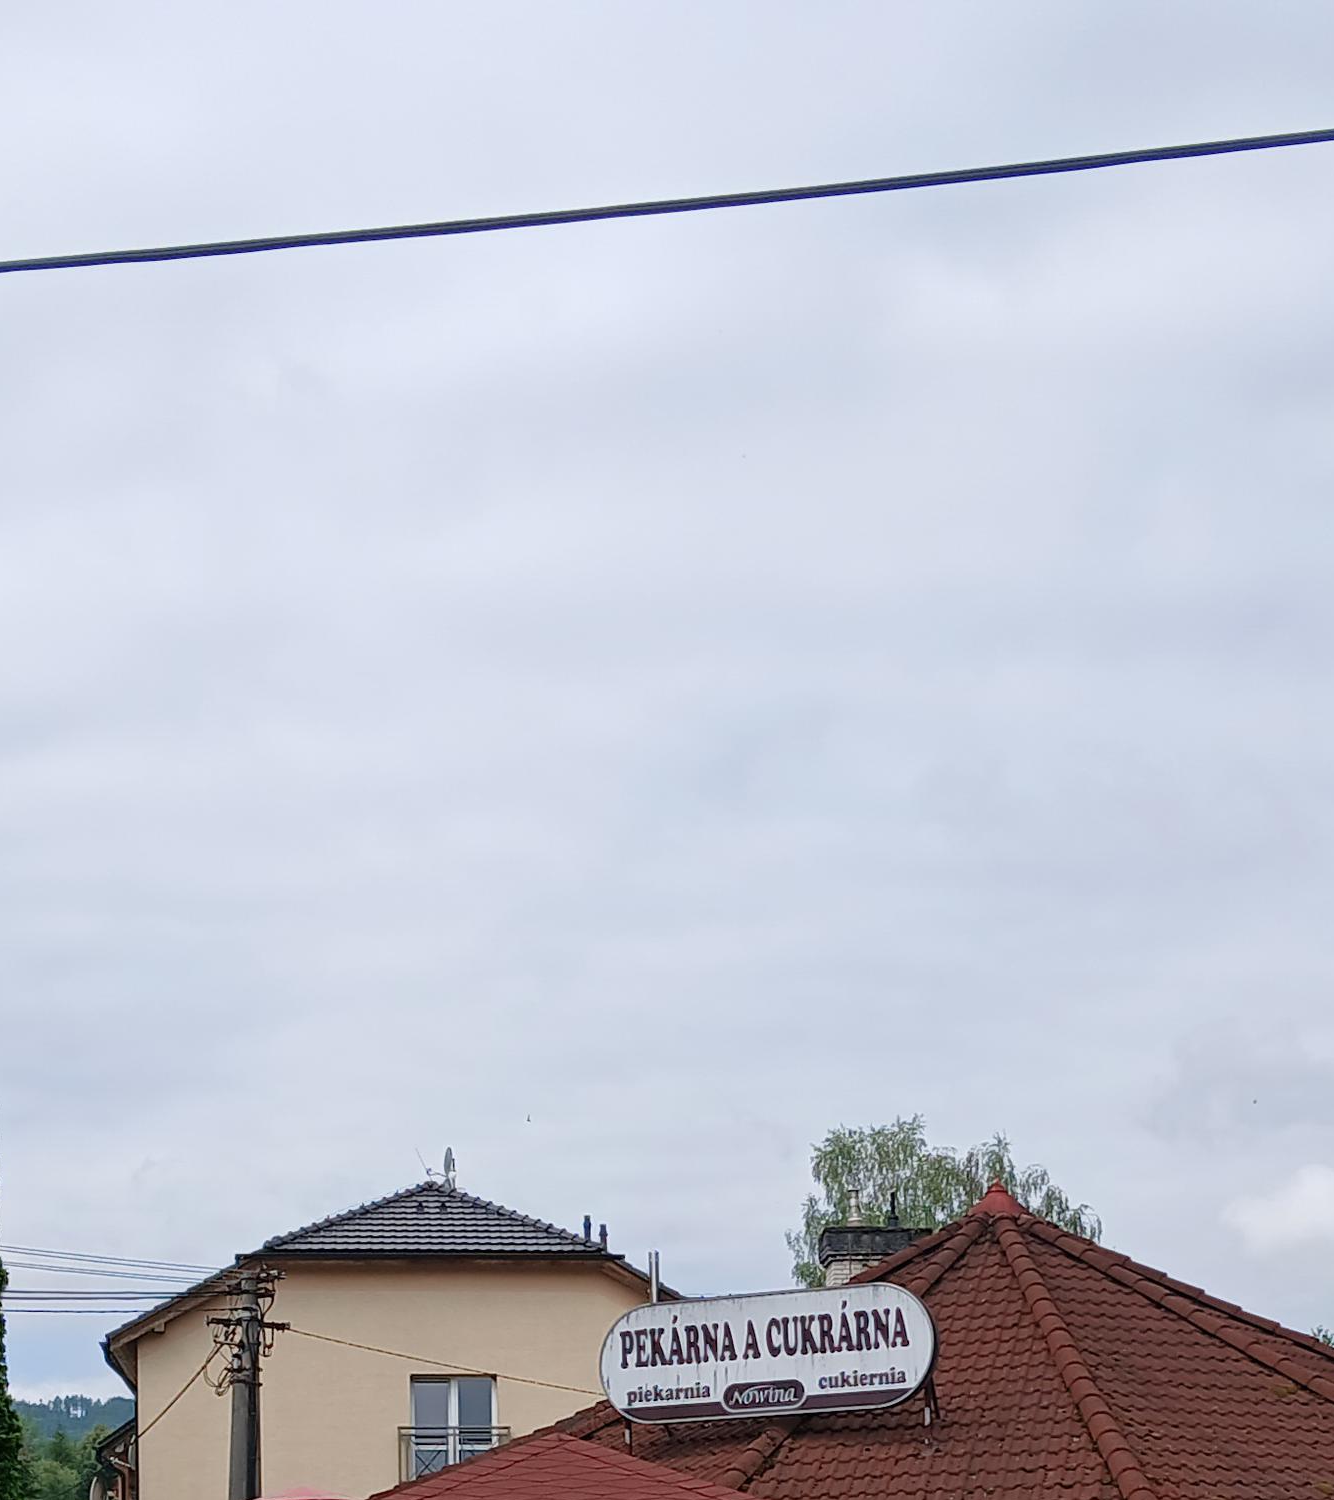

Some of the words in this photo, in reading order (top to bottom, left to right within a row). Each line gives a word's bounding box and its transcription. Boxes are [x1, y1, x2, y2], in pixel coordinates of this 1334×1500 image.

[619, 1315, 737, 1369] PEKÁRNA
[742, 1319, 762, 1360] A
[766, 1300, 910, 1357] CUKRÁRNA
[818, 1366, 907, 1390] cukiernia
[626, 1382, 711, 1406] piekarnia
